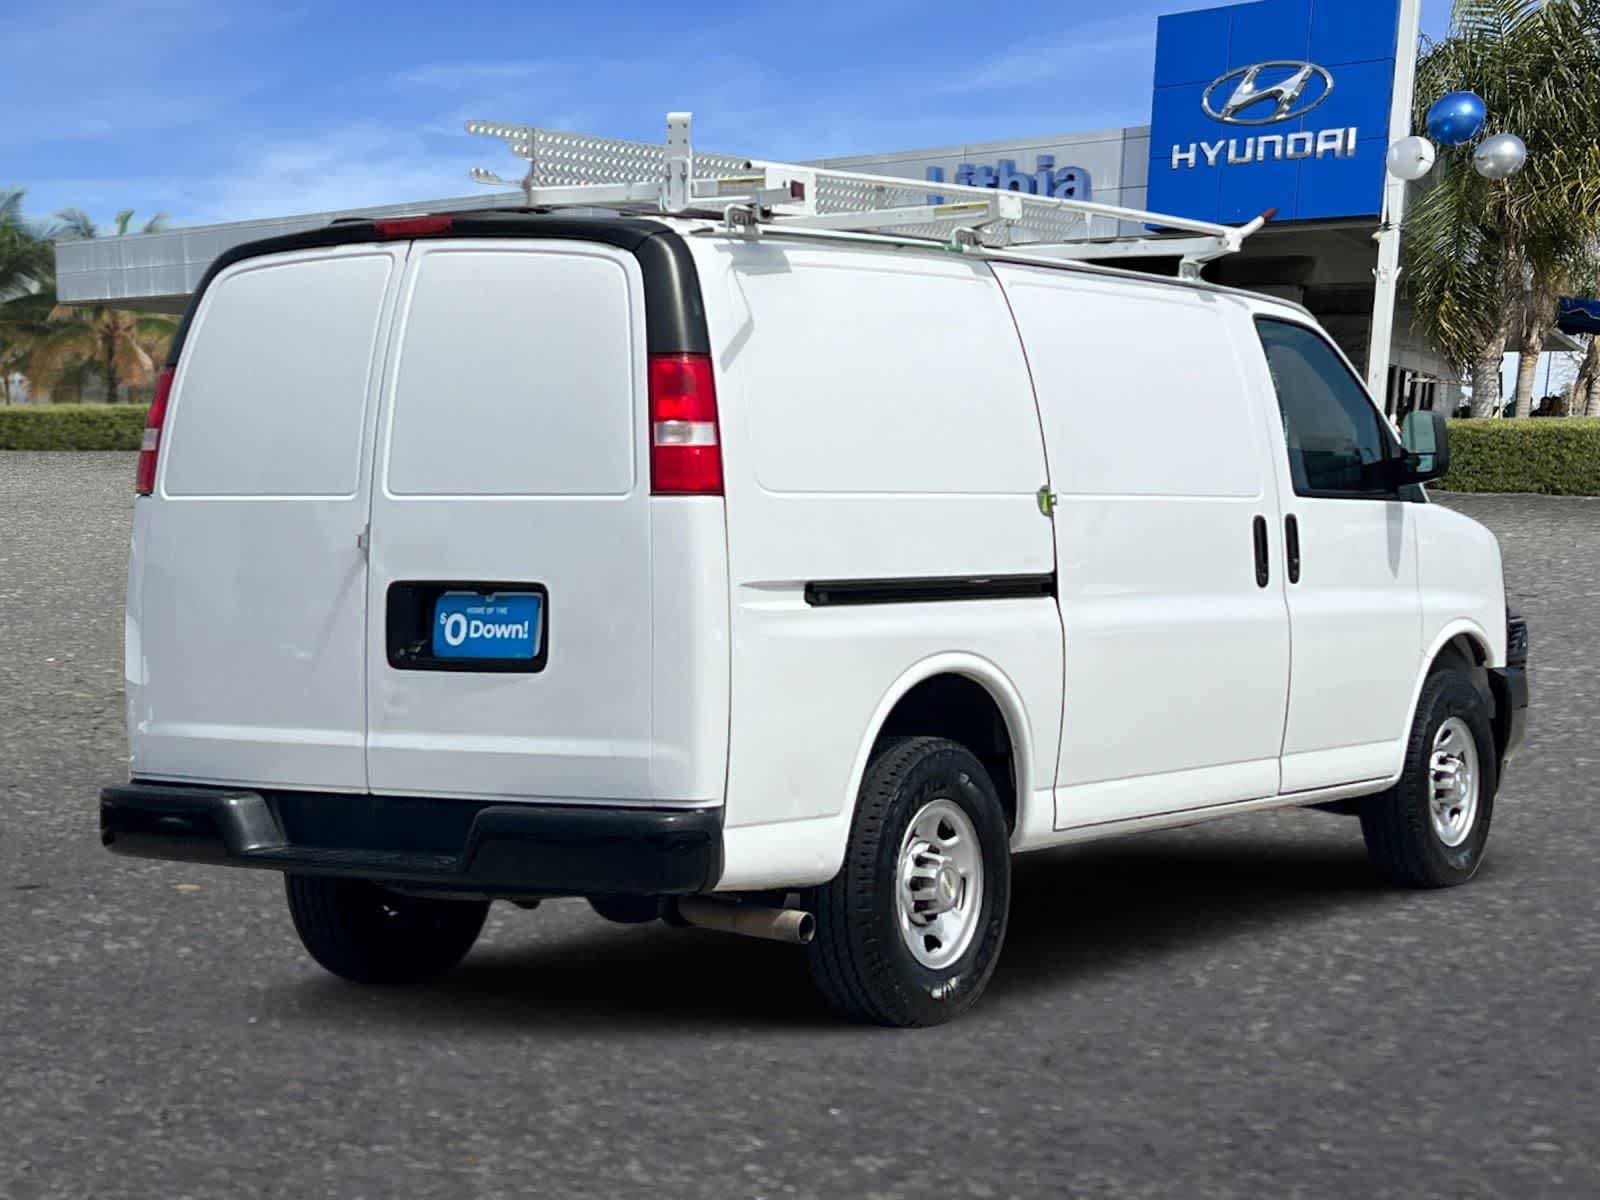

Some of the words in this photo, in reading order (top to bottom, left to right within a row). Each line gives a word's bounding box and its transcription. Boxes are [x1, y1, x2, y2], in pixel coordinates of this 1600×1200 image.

[1171, 127, 1357, 169] HYUNDAI
[440, 612, 467, 646] $0
[469, 620, 529, 639] Down!
